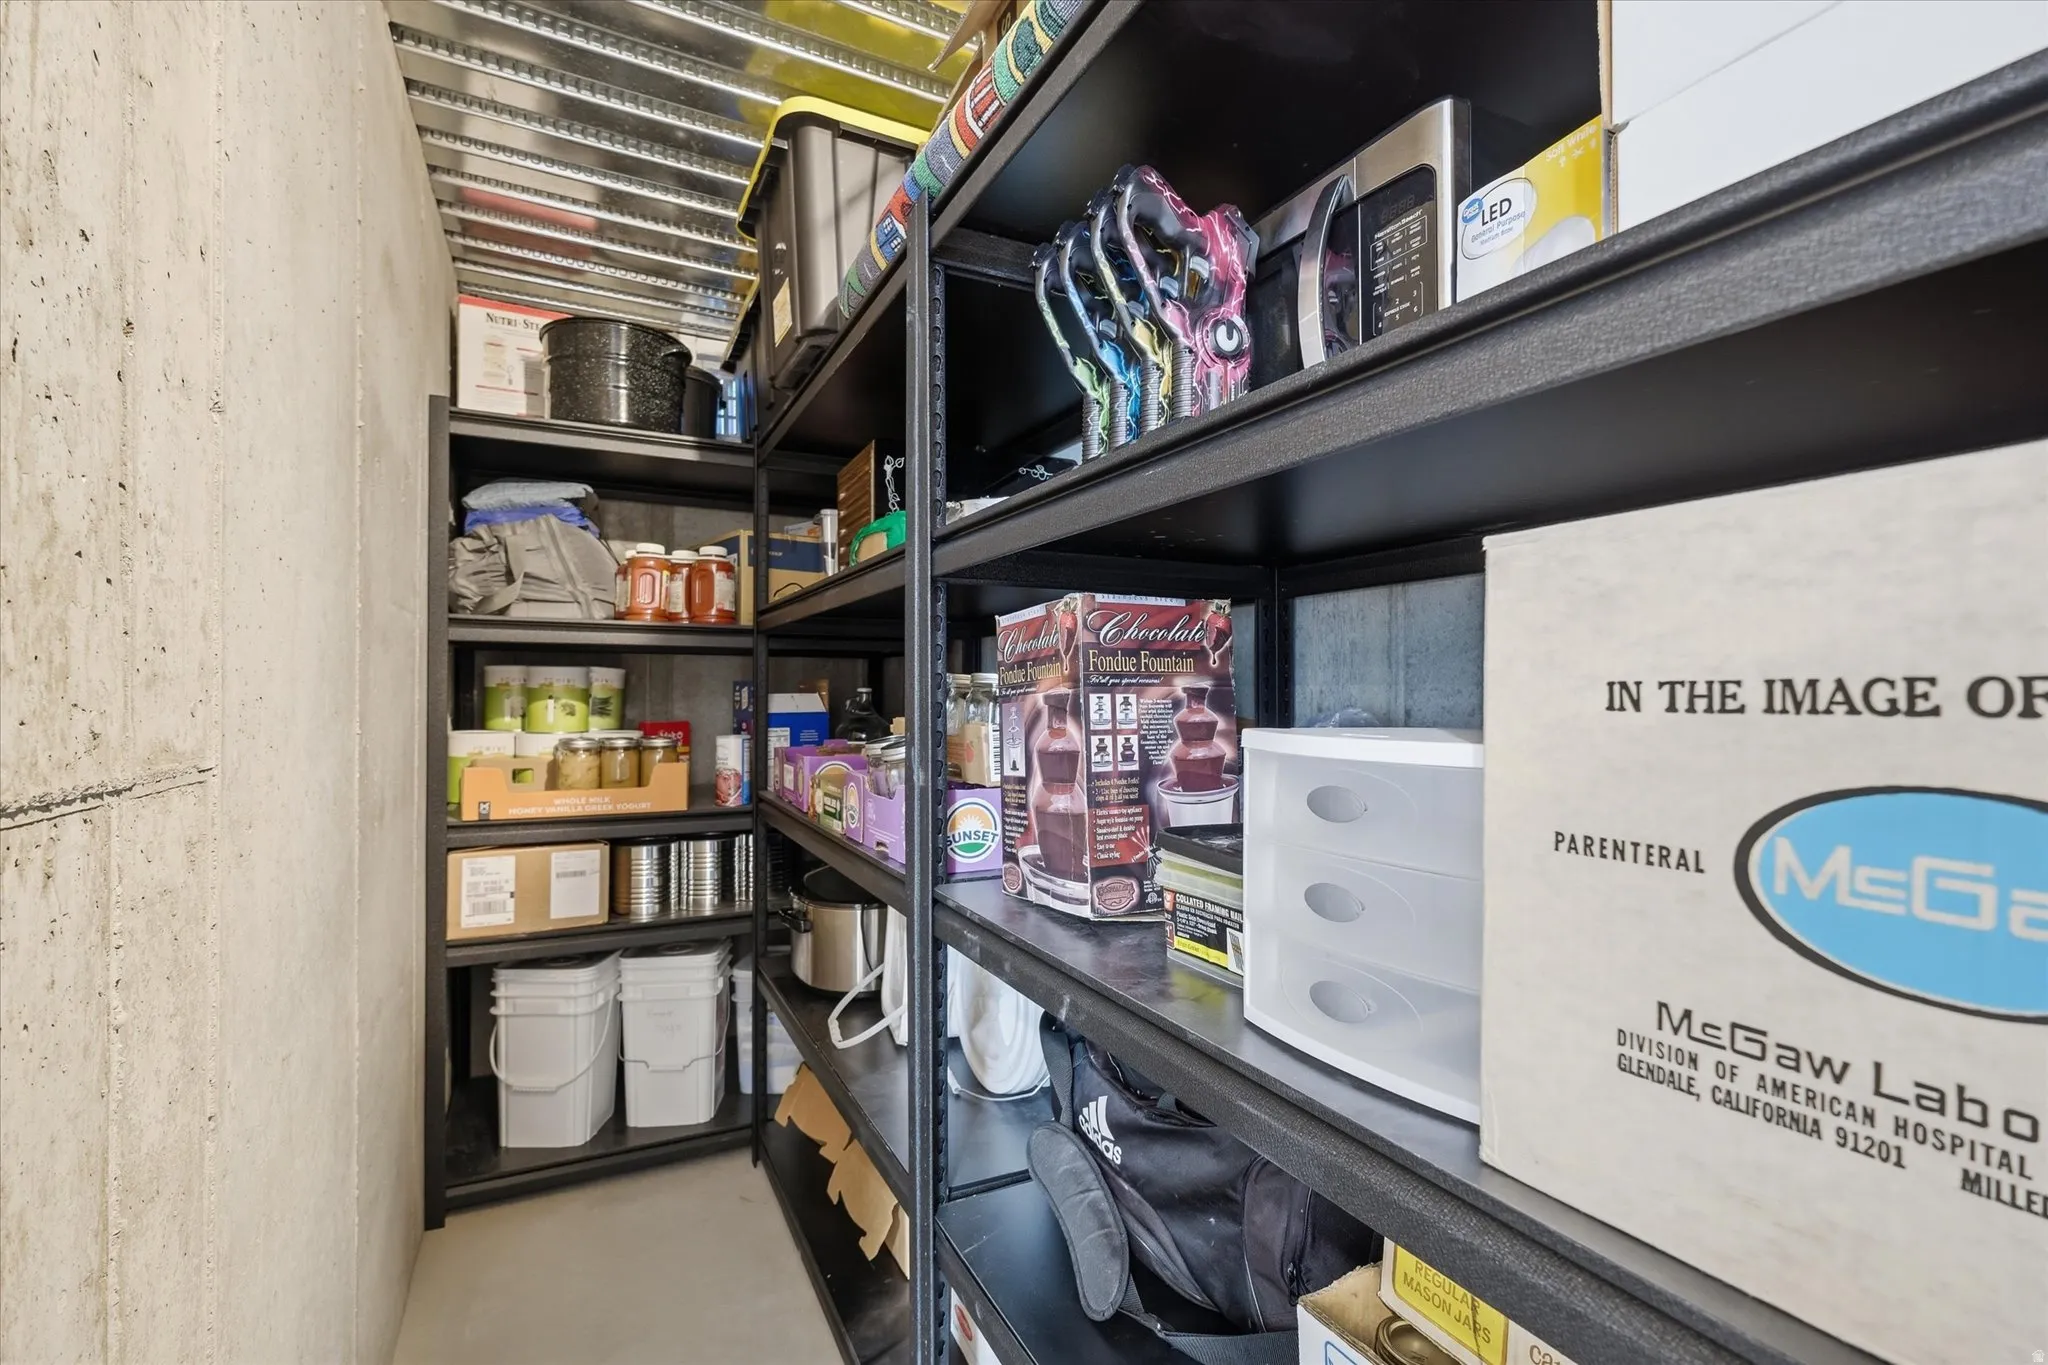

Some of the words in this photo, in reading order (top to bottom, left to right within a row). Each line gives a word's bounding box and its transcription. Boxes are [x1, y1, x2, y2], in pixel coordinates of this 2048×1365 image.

[1471, 224, 1495, 243] General
[1497, 210, 1526, 229] Purpose
[1481, 197, 1512, 227] LED
[997, 619, 1060, 663] Chocolate
[1086, 609, 1206, 647] Chocolate
[999, 665, 1026, 686] Fondue
[1026, 656, 1061, 682] Fountain
[1088, 649, 1137, 672] Fondue
[1139, 650, 1195, 673] Fountain
[1605, 680, 1643, 714] IN
[1657, 679, 1747, 716] THE
[1761, 675, 1943, 718] IMAGE
[508, 807, 543, 816] HONEY
[544, 804, 582, 814] VANILLA
[584, 803, 613, 812] GREEK
[616, 801, 652, 811] YOGURT
[553, 796, 586, 806] WHOLE
[946, 830, 999, 848] SUNSET
[1553, 830, 1706, 874] PARENTERAL
[1175, 893, 1204, 910] COLLATED
[1204, 901, 1230, 917] FRAMING
[1656, 1000, 1851, 1085] McGaw
[1873, 1060, 2040, 1144] Labo
[1616, 1028, 1700, 1073] DIVISION
[1715, 1059, 1740, 1085] OF
[1756, 1073, 1878, 1129] AMERICAN
[1893, 1115, 2034, 1181] HOSPITAL
[1616, 1052, 1702, 1102] GLENDALE,
[1711, 1085, 1823, 1141] CALIFORNIA
[1835, 1126, 1907, 1170] 91201
[1078, 1113, 1123, 1166] adidas
[1960, 1166, 2048, 1221] MILLE
[1402, 1271, 1452, 1319] MASON
[1453, 1311, 1492, 1346] JARS
[1413, 1258, 1482, 1317] REGULAR
